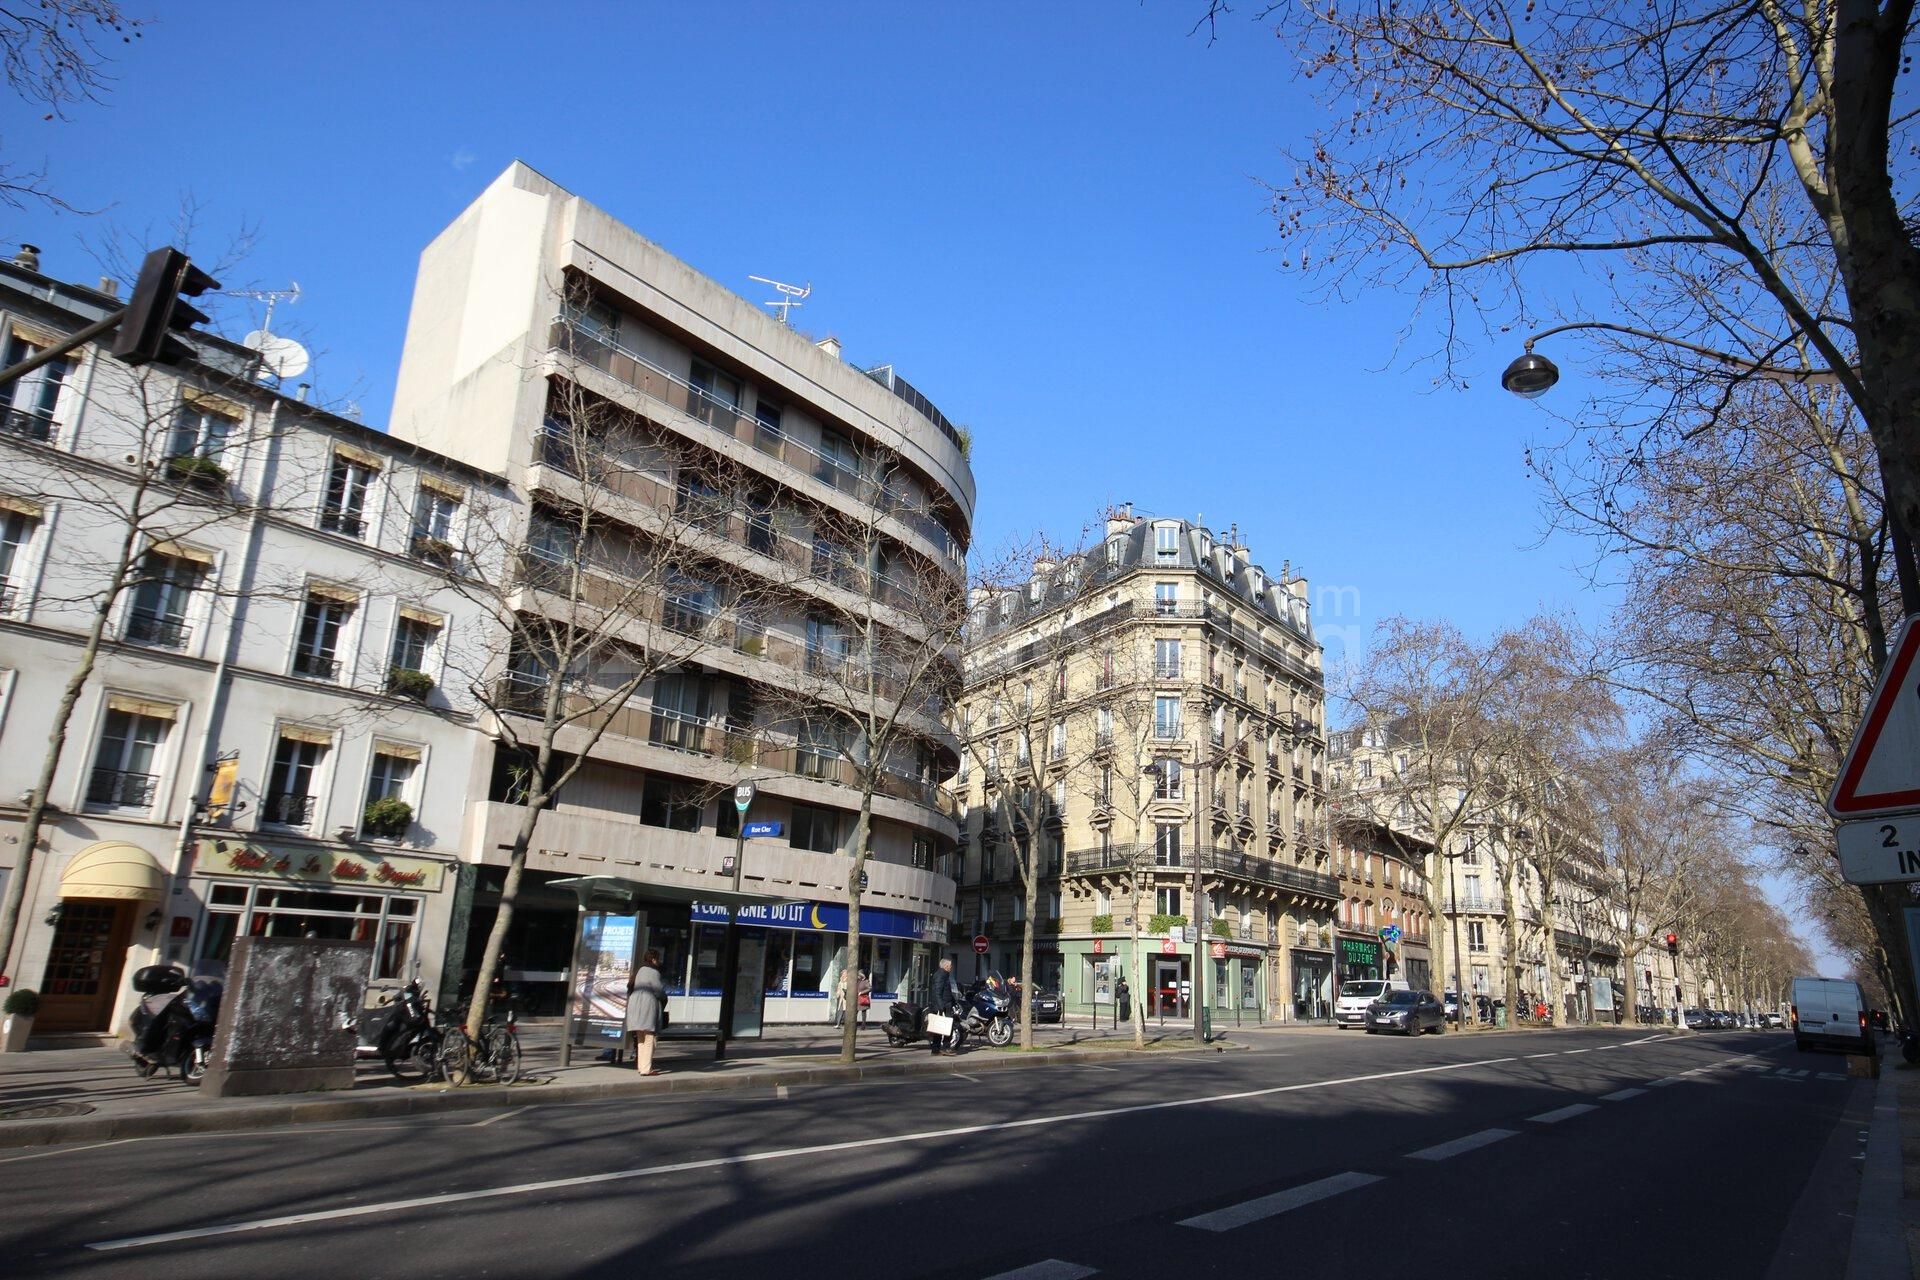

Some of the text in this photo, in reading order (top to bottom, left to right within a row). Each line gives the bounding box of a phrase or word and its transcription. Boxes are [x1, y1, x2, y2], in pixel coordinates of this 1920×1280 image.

[736, 786, 751, 797] BUS
[1879, 824, 1900, 848] 2
[771, 905, 786, 920] DU
[789, 905, 805, 921] LIT
